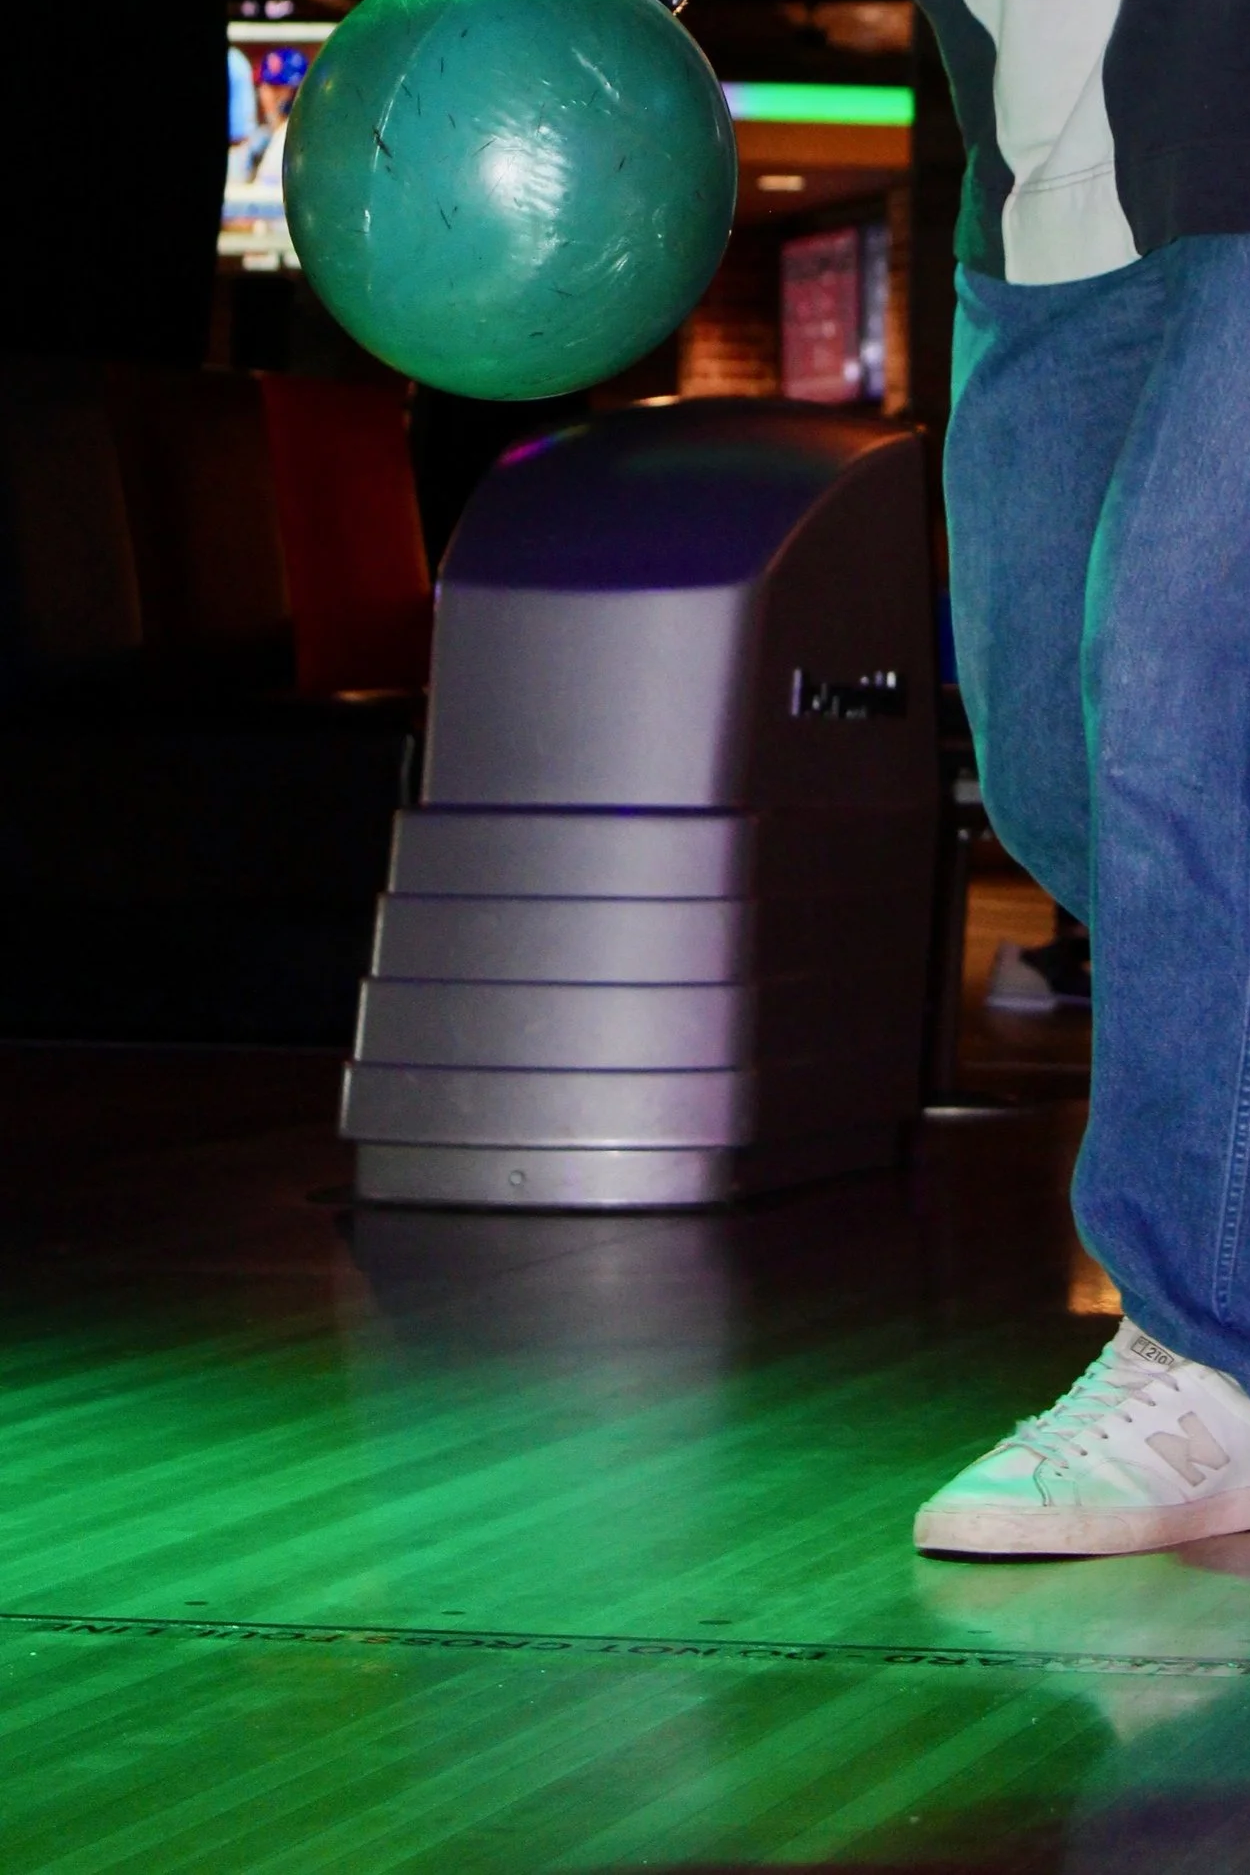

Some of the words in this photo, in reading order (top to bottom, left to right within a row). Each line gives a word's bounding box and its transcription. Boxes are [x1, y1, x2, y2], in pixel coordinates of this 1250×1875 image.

[1145, 1347, 1168, 1365] 210
[1145, 1411, 1231, 1486] N
[29, 1622, 167, 1637] LINE
[188, 1627, 345, 1642] FOUL
[359, 1635, 573, 1650] CROSS
[584, 1644, 721, 1657] NOT
